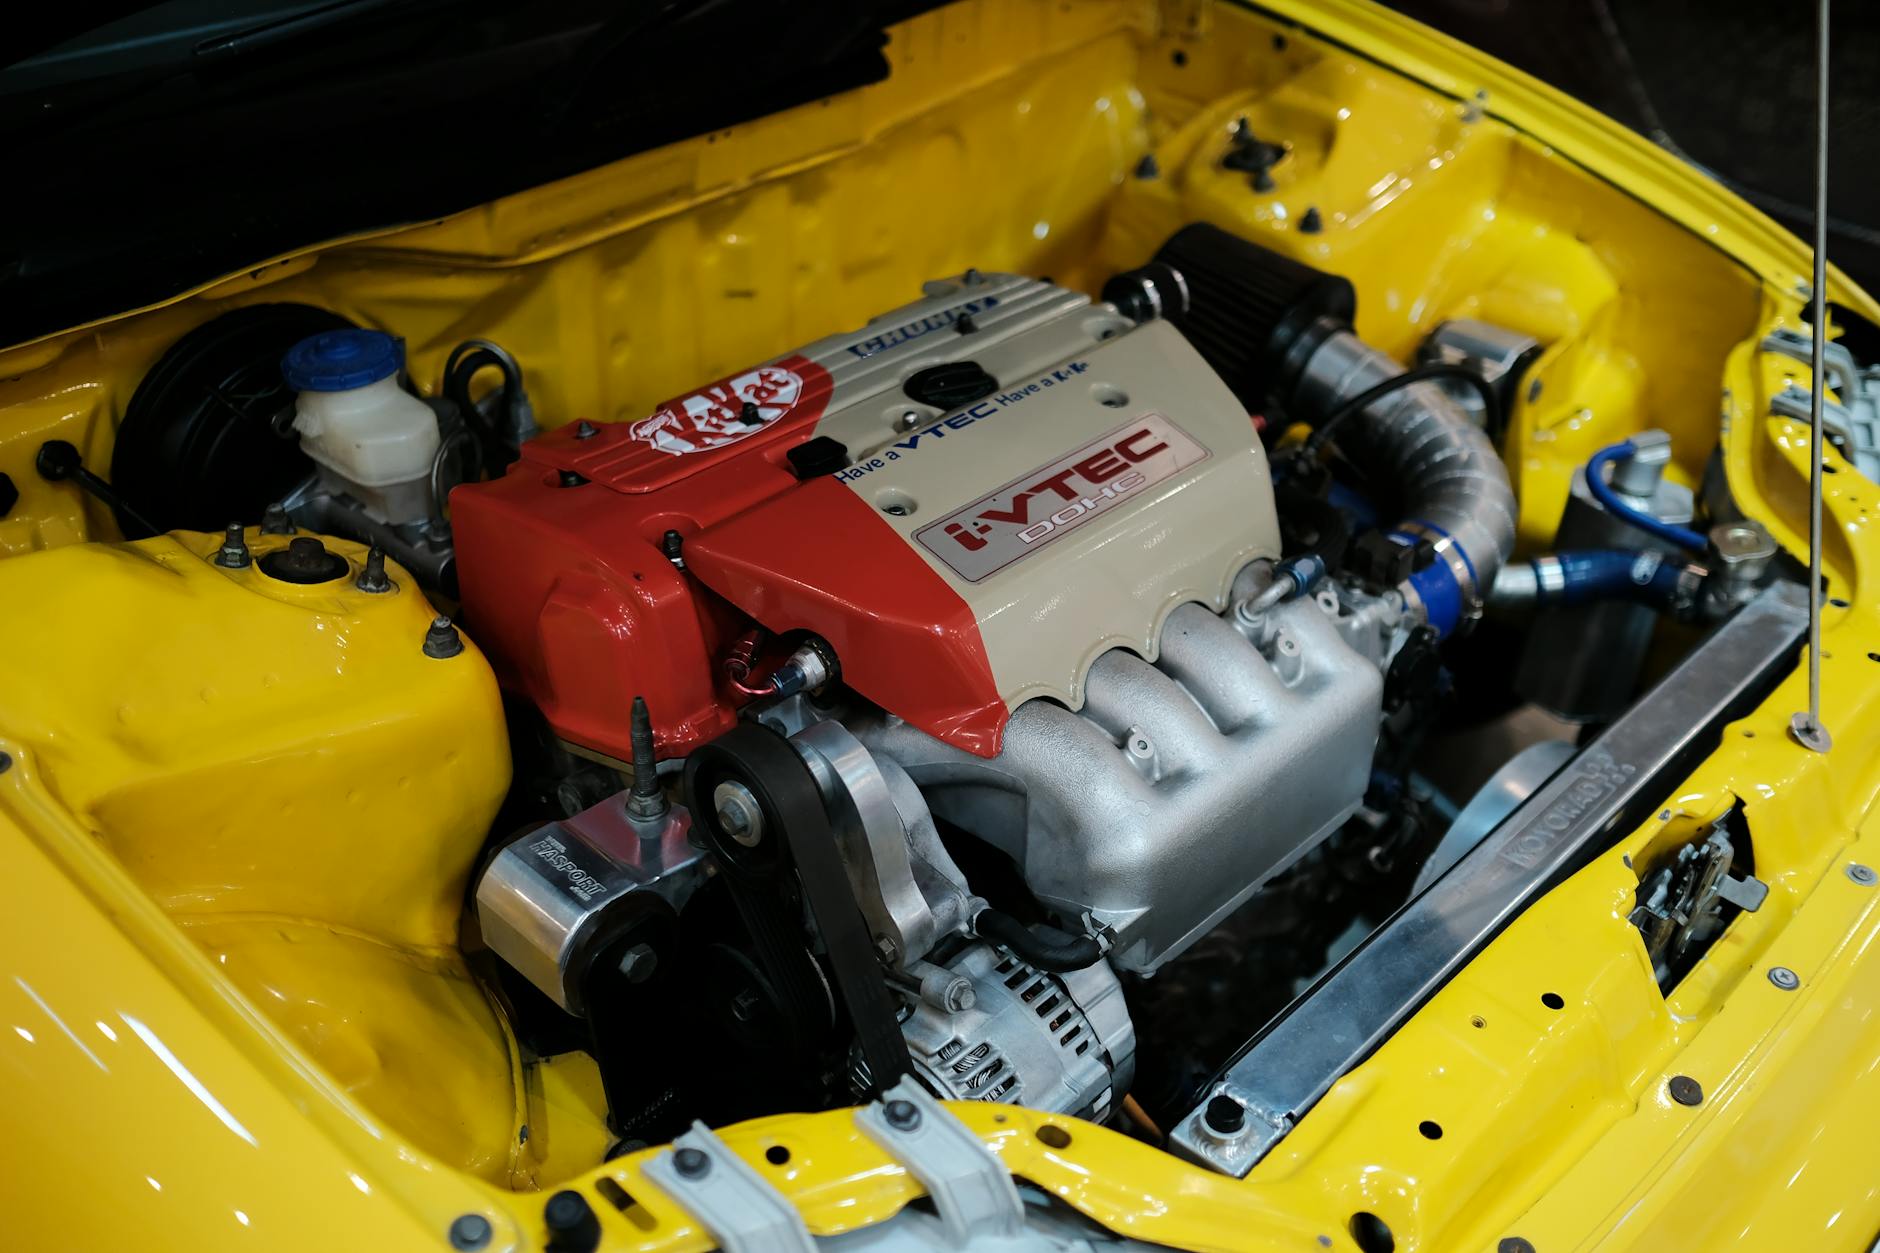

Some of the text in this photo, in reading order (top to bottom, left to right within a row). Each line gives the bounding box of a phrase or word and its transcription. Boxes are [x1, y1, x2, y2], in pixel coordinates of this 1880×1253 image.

[832, 378, 1055, 485] Have a VTEC Have a
[944, 428, 1170, 552] i-VTEC
[1016, 472, 1147, 545] DOHC
[528, 840, 608, 896] HASPORT
